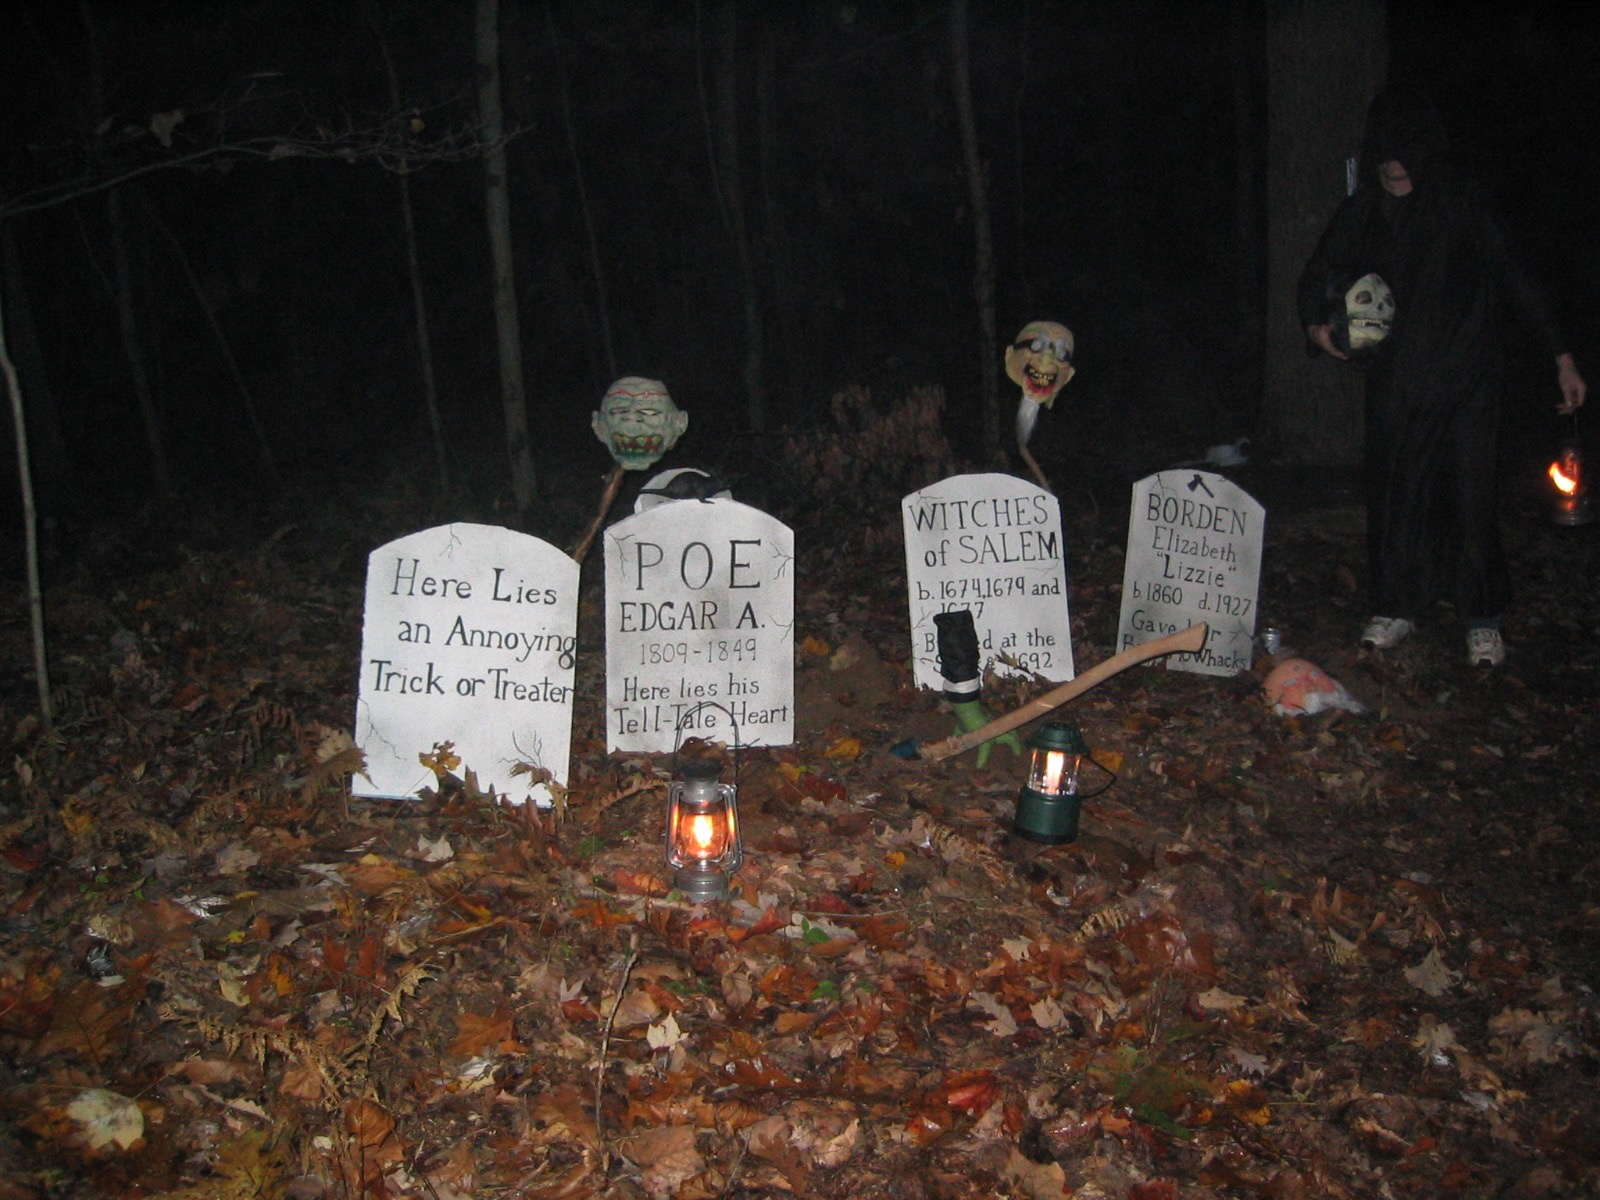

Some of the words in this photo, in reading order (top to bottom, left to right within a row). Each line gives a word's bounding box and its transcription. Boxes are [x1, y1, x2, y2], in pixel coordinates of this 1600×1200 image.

[909, 495, 1048, 532] WITCHES
[1147, 494, 1247, 536] BORDEN
[925, 540, 949, 567] of
[959, 531, 1059, 564] SALEM
[1152, 525, 1236, 563] Elizabeth
[390, 557, 472, 598] Here
[492, 568, 557, 605] Lies
[635, 539, 761, 590] POE
[1032, 578, 1060, 595] and
[620, 601, 718, 632] EDGAR
[736, 601, 766, 630] A.
[1131, 610, 1176, 633] Gave
[398, 620, 431, 644] an
[445, 615, 576, 669] Annoying
[640, 638, 757, 665] 1809-1849
[1002, 633, 1018, 648] at
[1027, 628, 1055, 646] the
[370, 659, 445, 695] Trick
[456, 677, 485, 696] or
[488, 668, 575, 703] Treater
[624, 677, 670, 701] Here
[680, 678, 718, 698] lies
[727, 673, 759, 696] his
[730, 701, 788, 726] Heart
